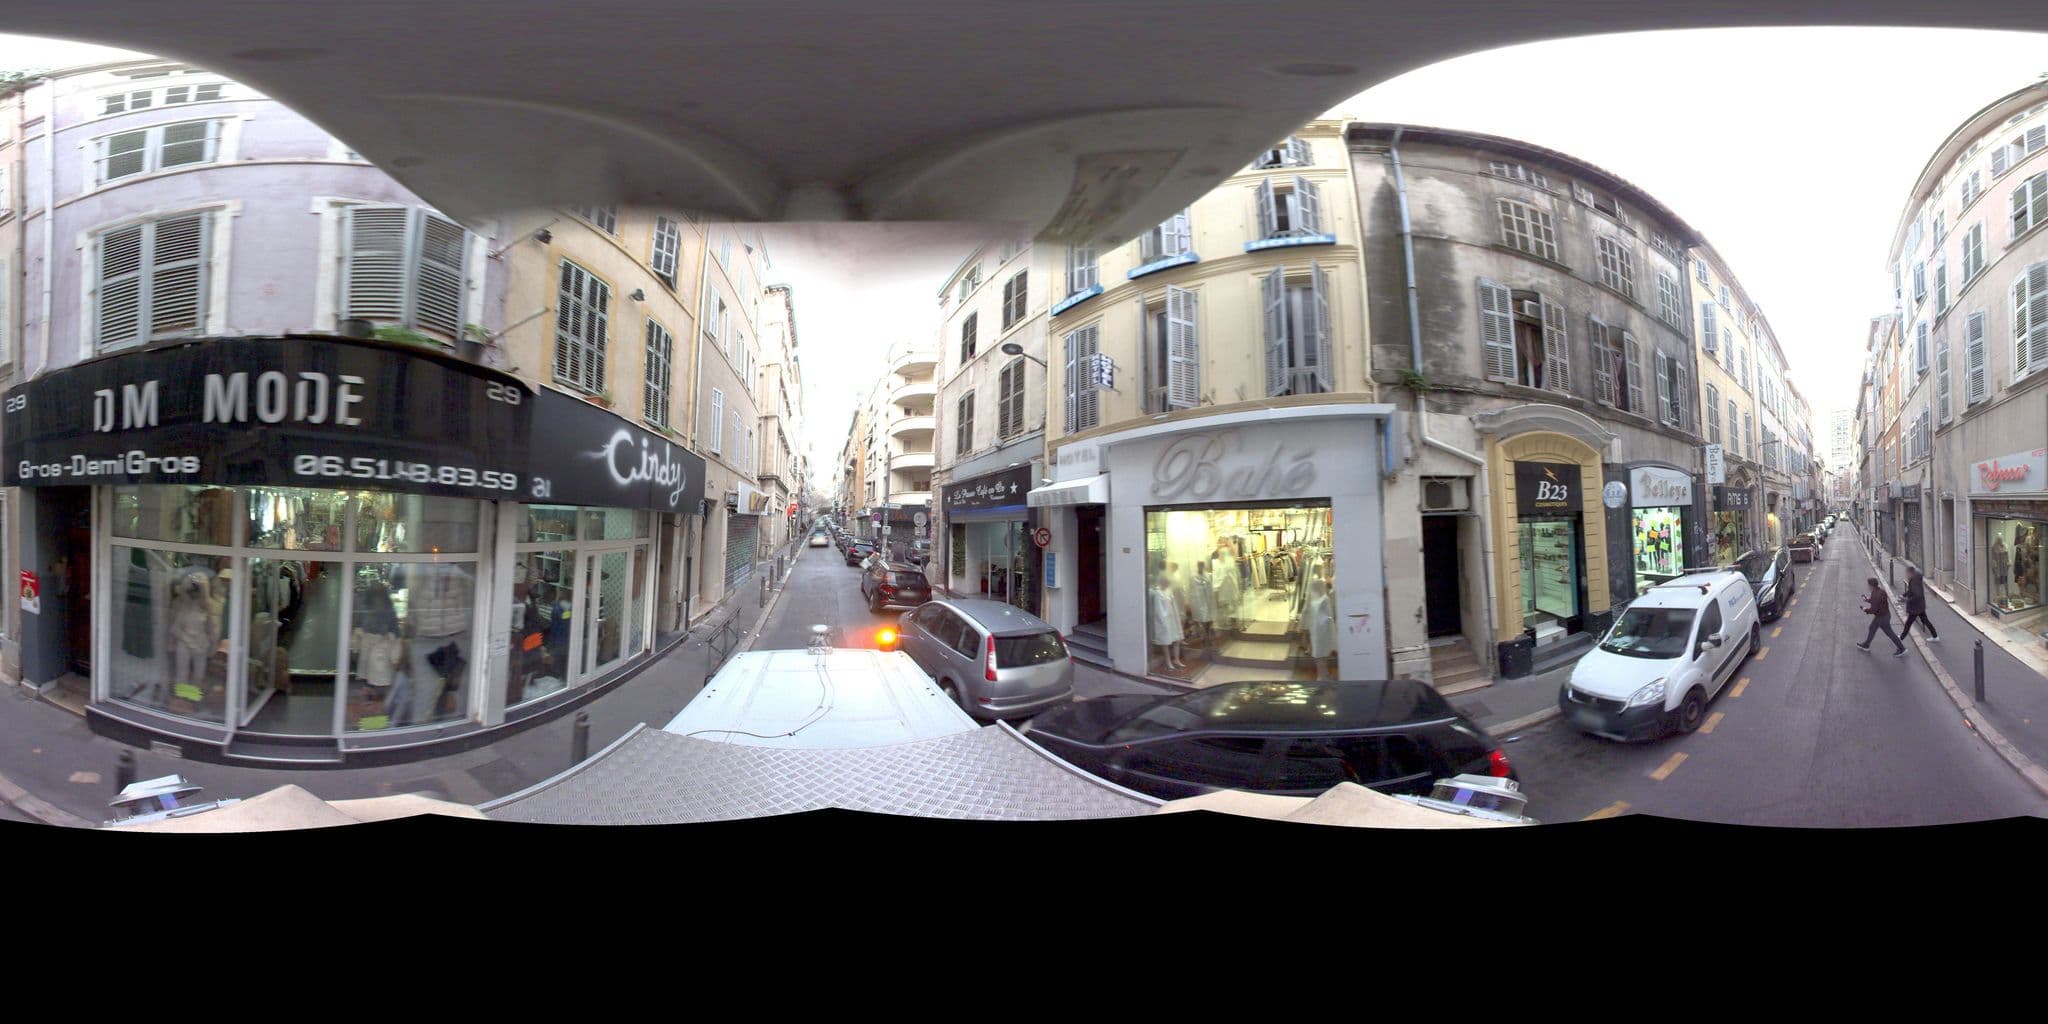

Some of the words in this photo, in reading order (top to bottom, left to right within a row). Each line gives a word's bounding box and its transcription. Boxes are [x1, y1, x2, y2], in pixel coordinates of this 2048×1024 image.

[6, 394, 27, 413] 29
[94, 380, 159, 432] DM
[203, 371, 364, 425] MODE
[487, 382, 521, 405] 29
[19, 450, 200, 479] Gros-DemiGros
[603, 429, 686, 507] Cindy
[1060, 449, 1096, 465] HOTEL
[1536, 481, 1567, 500] B23
